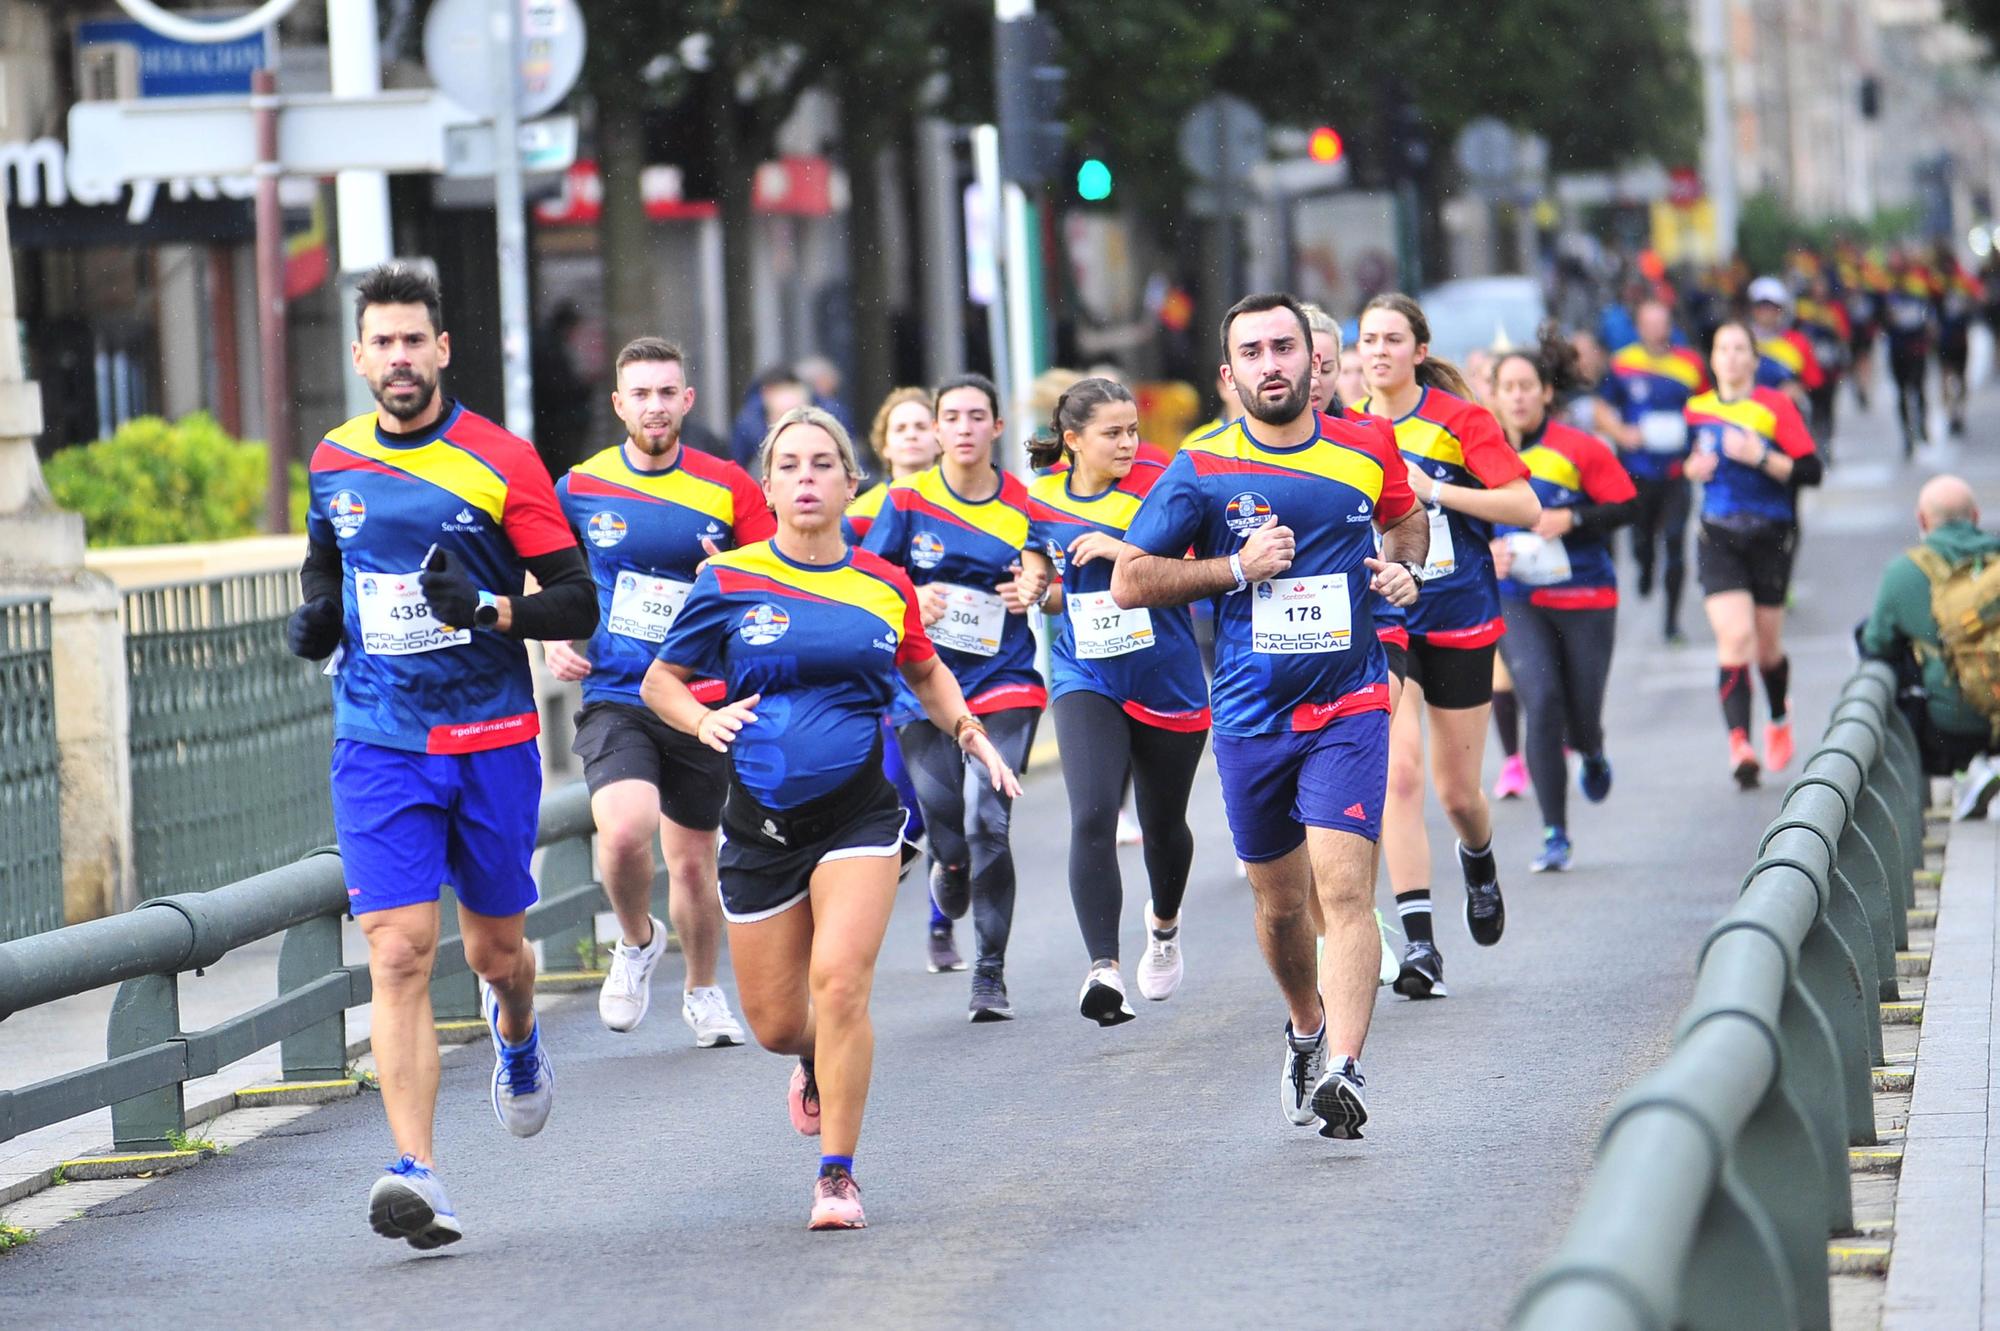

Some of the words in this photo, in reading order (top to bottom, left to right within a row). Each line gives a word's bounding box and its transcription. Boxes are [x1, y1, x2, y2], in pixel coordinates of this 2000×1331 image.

[390, 603, 428, 620] 438
[642, 601, 673, 617] 529
[1285, 606, 1322, 622] 178
[612, 616, 667, 633] POLICI
[951, 610, 980, 626] 304
[1091, 614, 1121, 630] 327
[365, 627, 443, 641] POLICIA
[611, 623, 666, 640] NACION
[1255, 631, 1333, 642] POLICIA
[366, 633, 467, 651] NACIONAL
[1079, 634, 1134, 648] POLICIA
[1080, 639, 1153, 655] NACIONAL
[1256, 639, 1350, 651] NACIONAL
